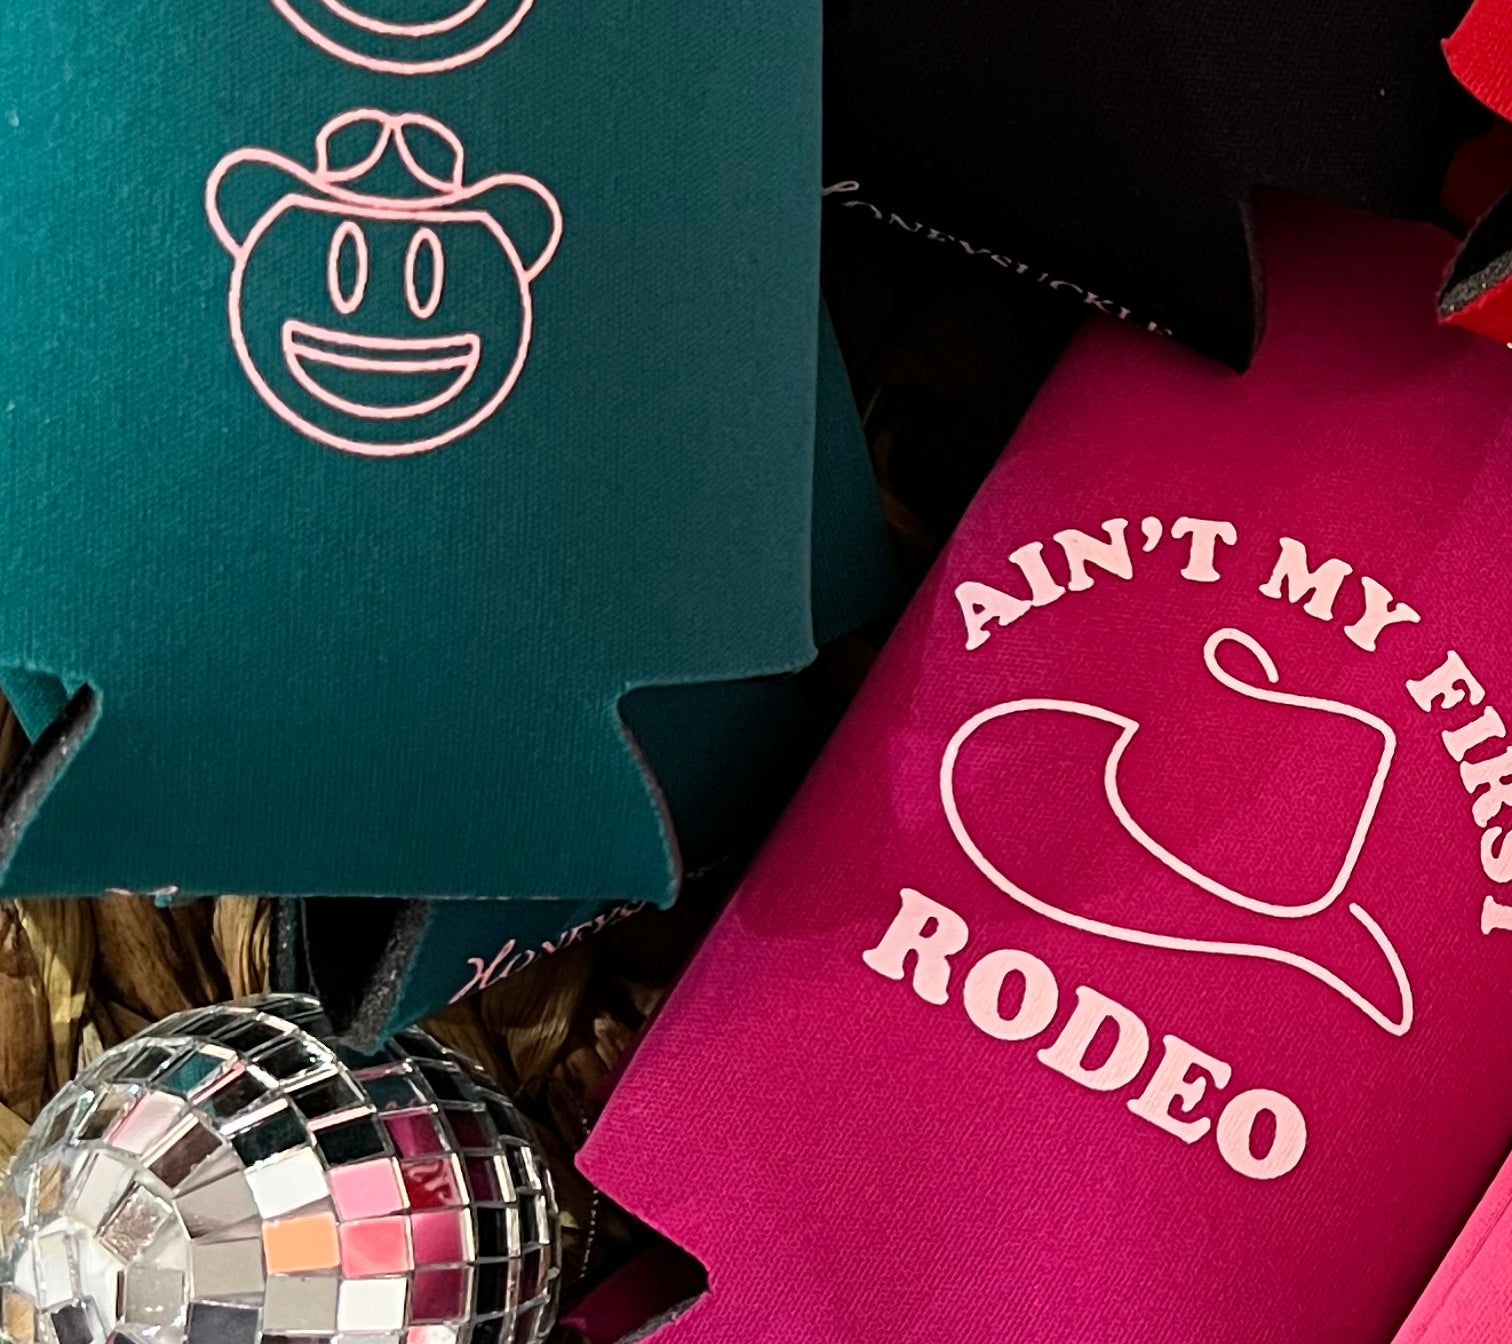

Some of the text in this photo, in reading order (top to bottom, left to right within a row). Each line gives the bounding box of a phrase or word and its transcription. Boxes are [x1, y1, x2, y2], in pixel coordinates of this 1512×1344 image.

[954, 516, 1238, 651] AIN'T
[1258, 537, 1421, 652] MY
[862, 887, 1307, 1180] RODEO
